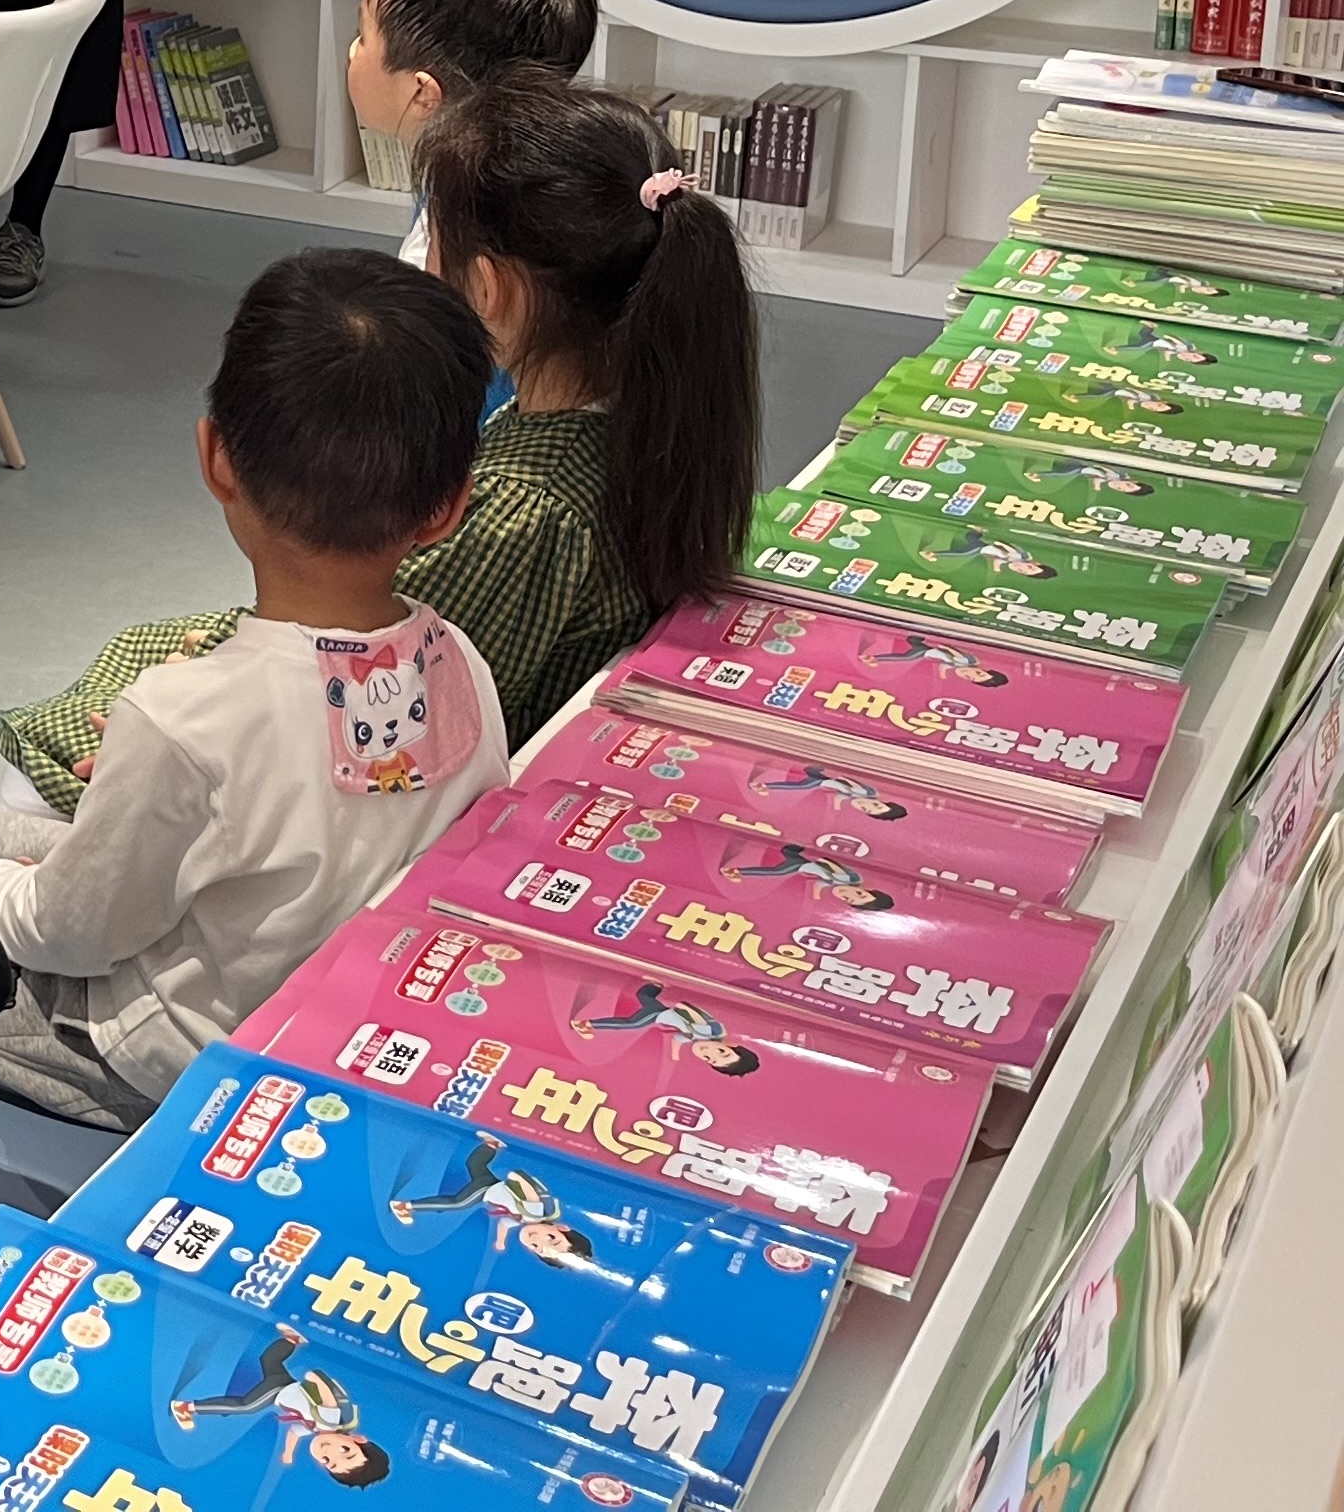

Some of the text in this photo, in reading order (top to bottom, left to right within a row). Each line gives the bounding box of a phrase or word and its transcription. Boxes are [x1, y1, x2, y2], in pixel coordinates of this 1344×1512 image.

[984, 494, 1251, 563] 奔跑吧少年
[874, 571, 1158, 651] 奔跑吧少年
[814, 682, 1121, 775] 奔跑吧少年
[564, 803, 624, 852] 教师专享
[540, 876, 583, 908] 英语
[404, 939, 468, 1001] 教师专享
[656, 900, 1018, 1036] 奔跑吧少年
[375, 1040, 420, 1077] 英语
[212, 1093, 290, 1178] 教师专享
[501, 1066, 903, 1238] 奔跑吧少年
[174, 1218, 225, 1262] 数学
[303, 1256, 726, 1462] 奔跑吧少年
